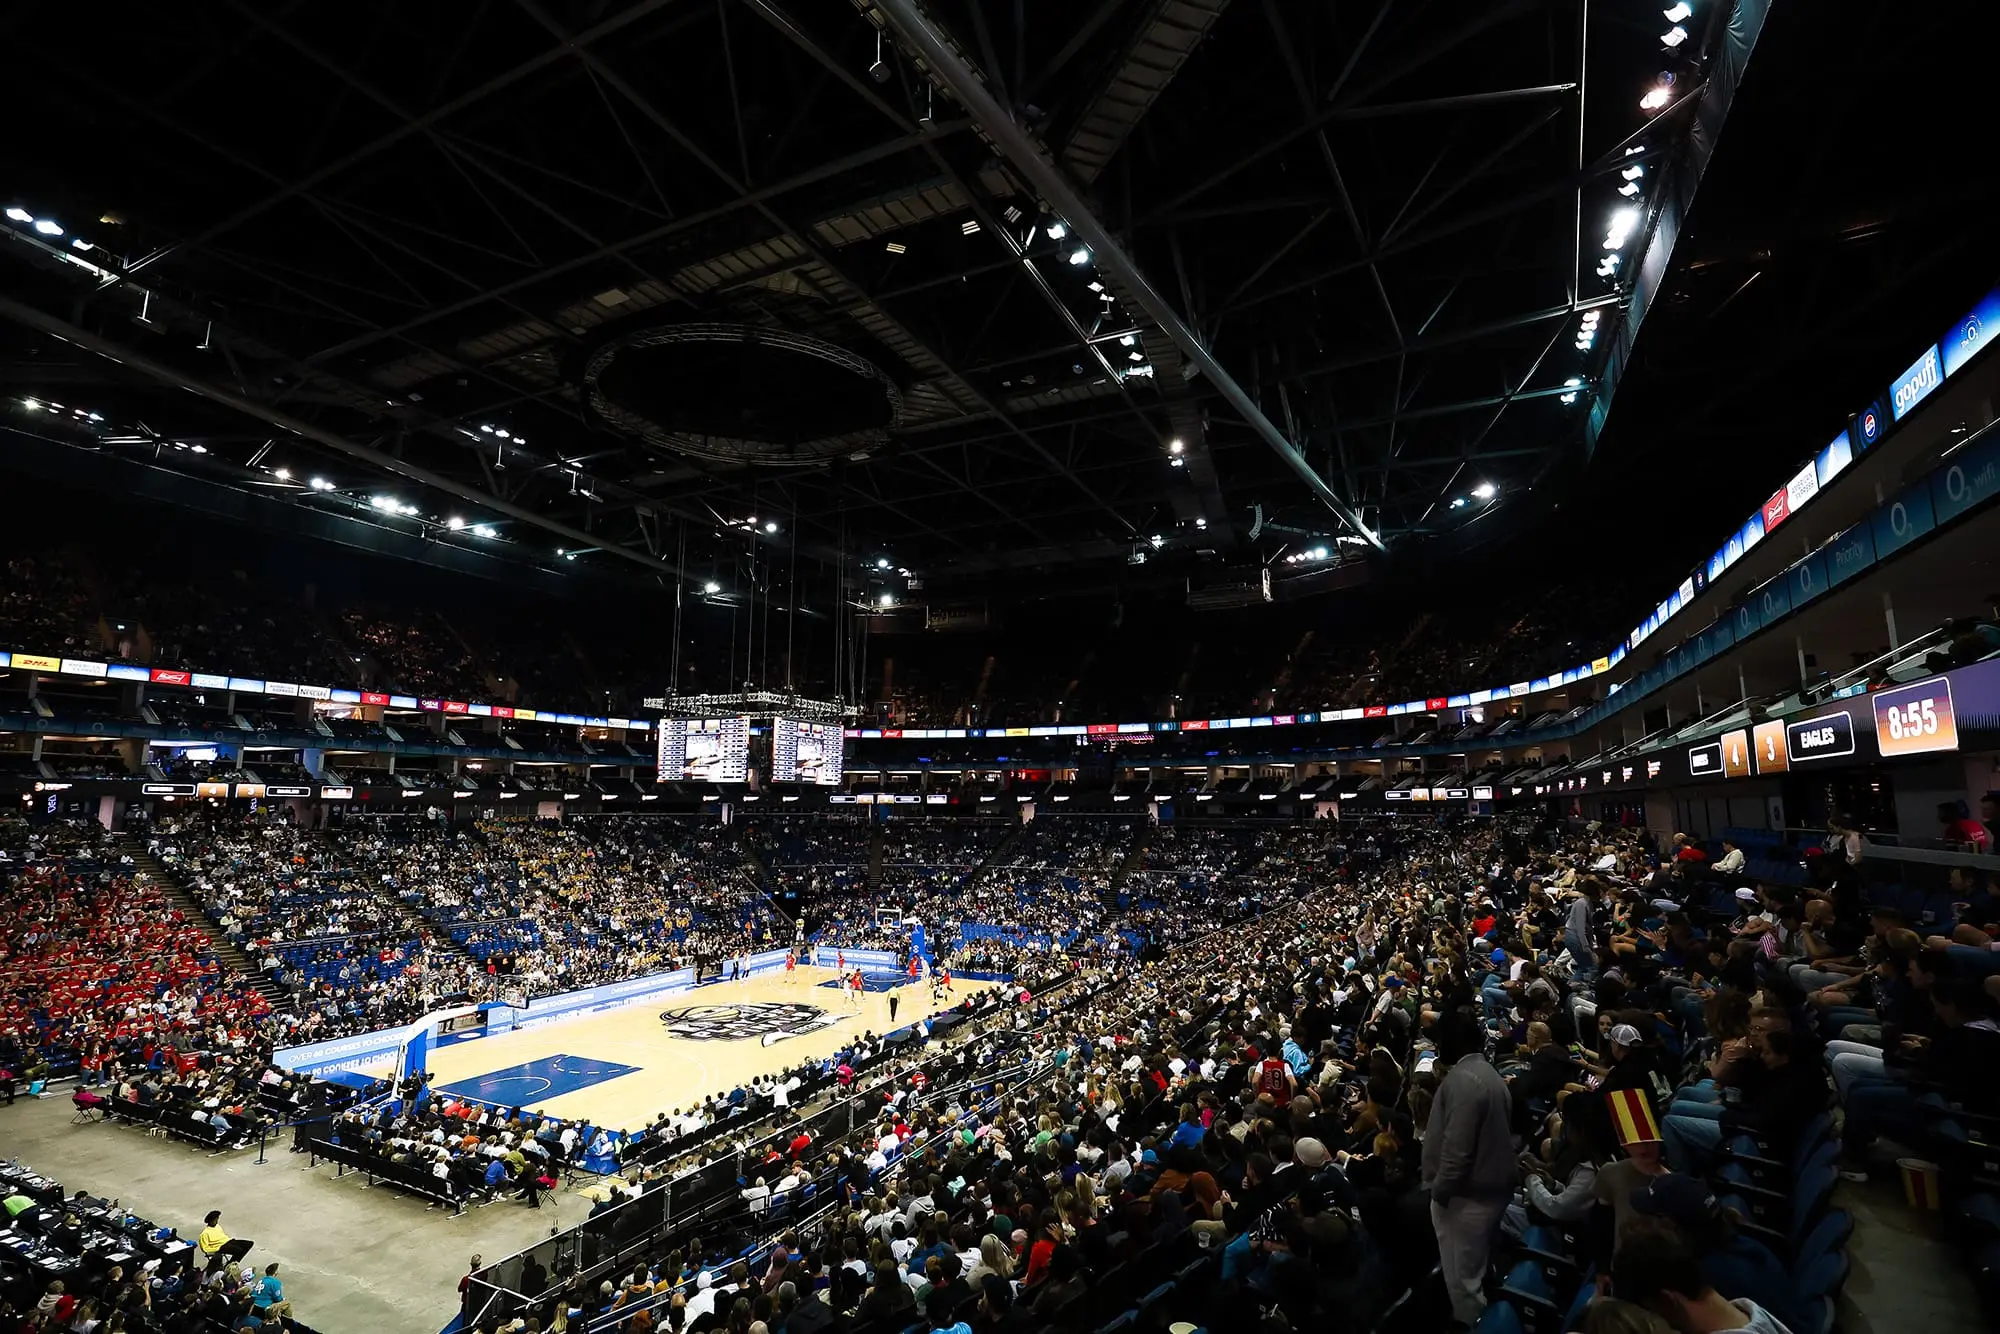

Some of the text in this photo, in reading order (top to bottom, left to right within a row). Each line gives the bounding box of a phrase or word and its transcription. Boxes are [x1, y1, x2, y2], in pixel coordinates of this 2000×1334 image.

[1895, 351, 1937, 414] gopuff
[1835, 537, 1864, 568] Priority
[22, 659, 49, 667] DHL
[1887, 698, 1938, 740] 8:55
[1765, 735, 1776, 762] 3
[1800, 726, 1835, 749] EAGLES
[1731, 743, 1740, 767] 4
[288, 1051, 313, 1063] OVER
[324, 1041, 362, 1055] COURSES
